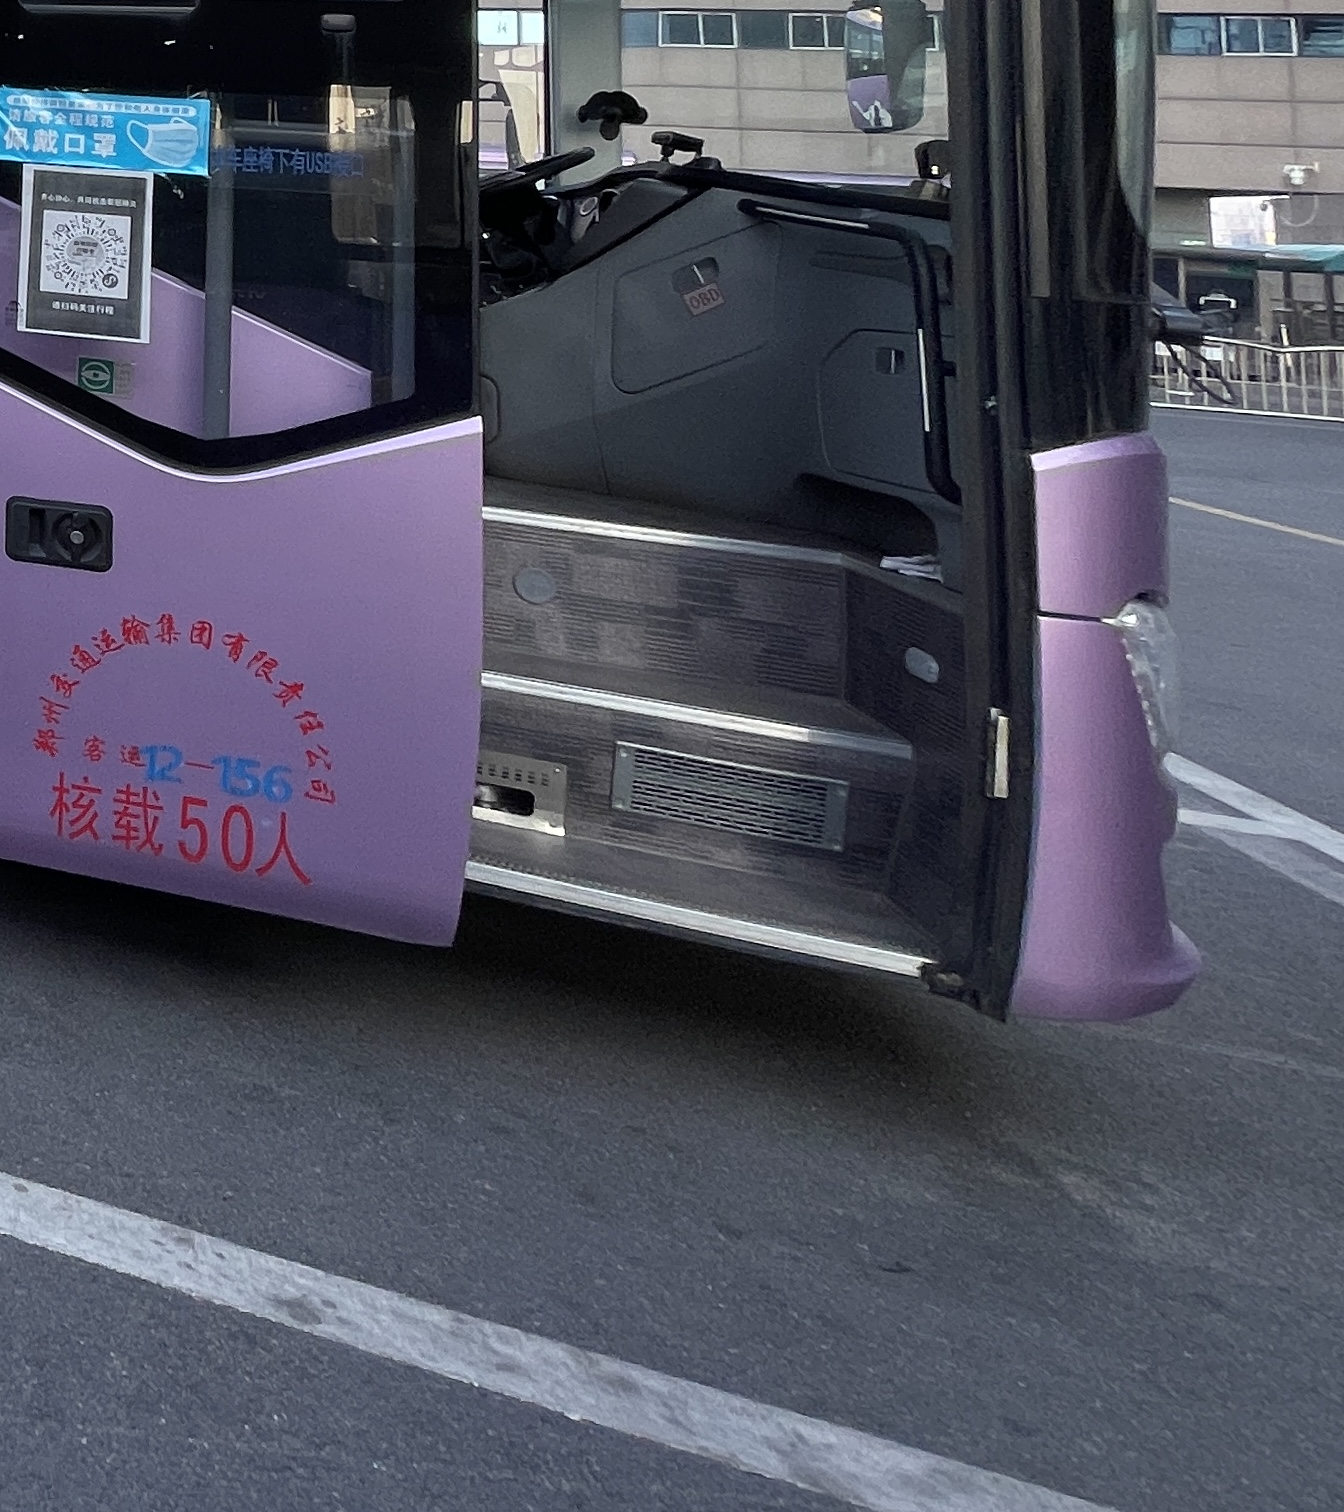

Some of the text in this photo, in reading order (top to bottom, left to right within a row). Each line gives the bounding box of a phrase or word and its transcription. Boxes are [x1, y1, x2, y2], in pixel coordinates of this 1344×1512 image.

[2, 125, 118, 159] 佩戴口罩
[689, 288, 721, 310] OBD
[49, 771, 313, 886] 核载50人
